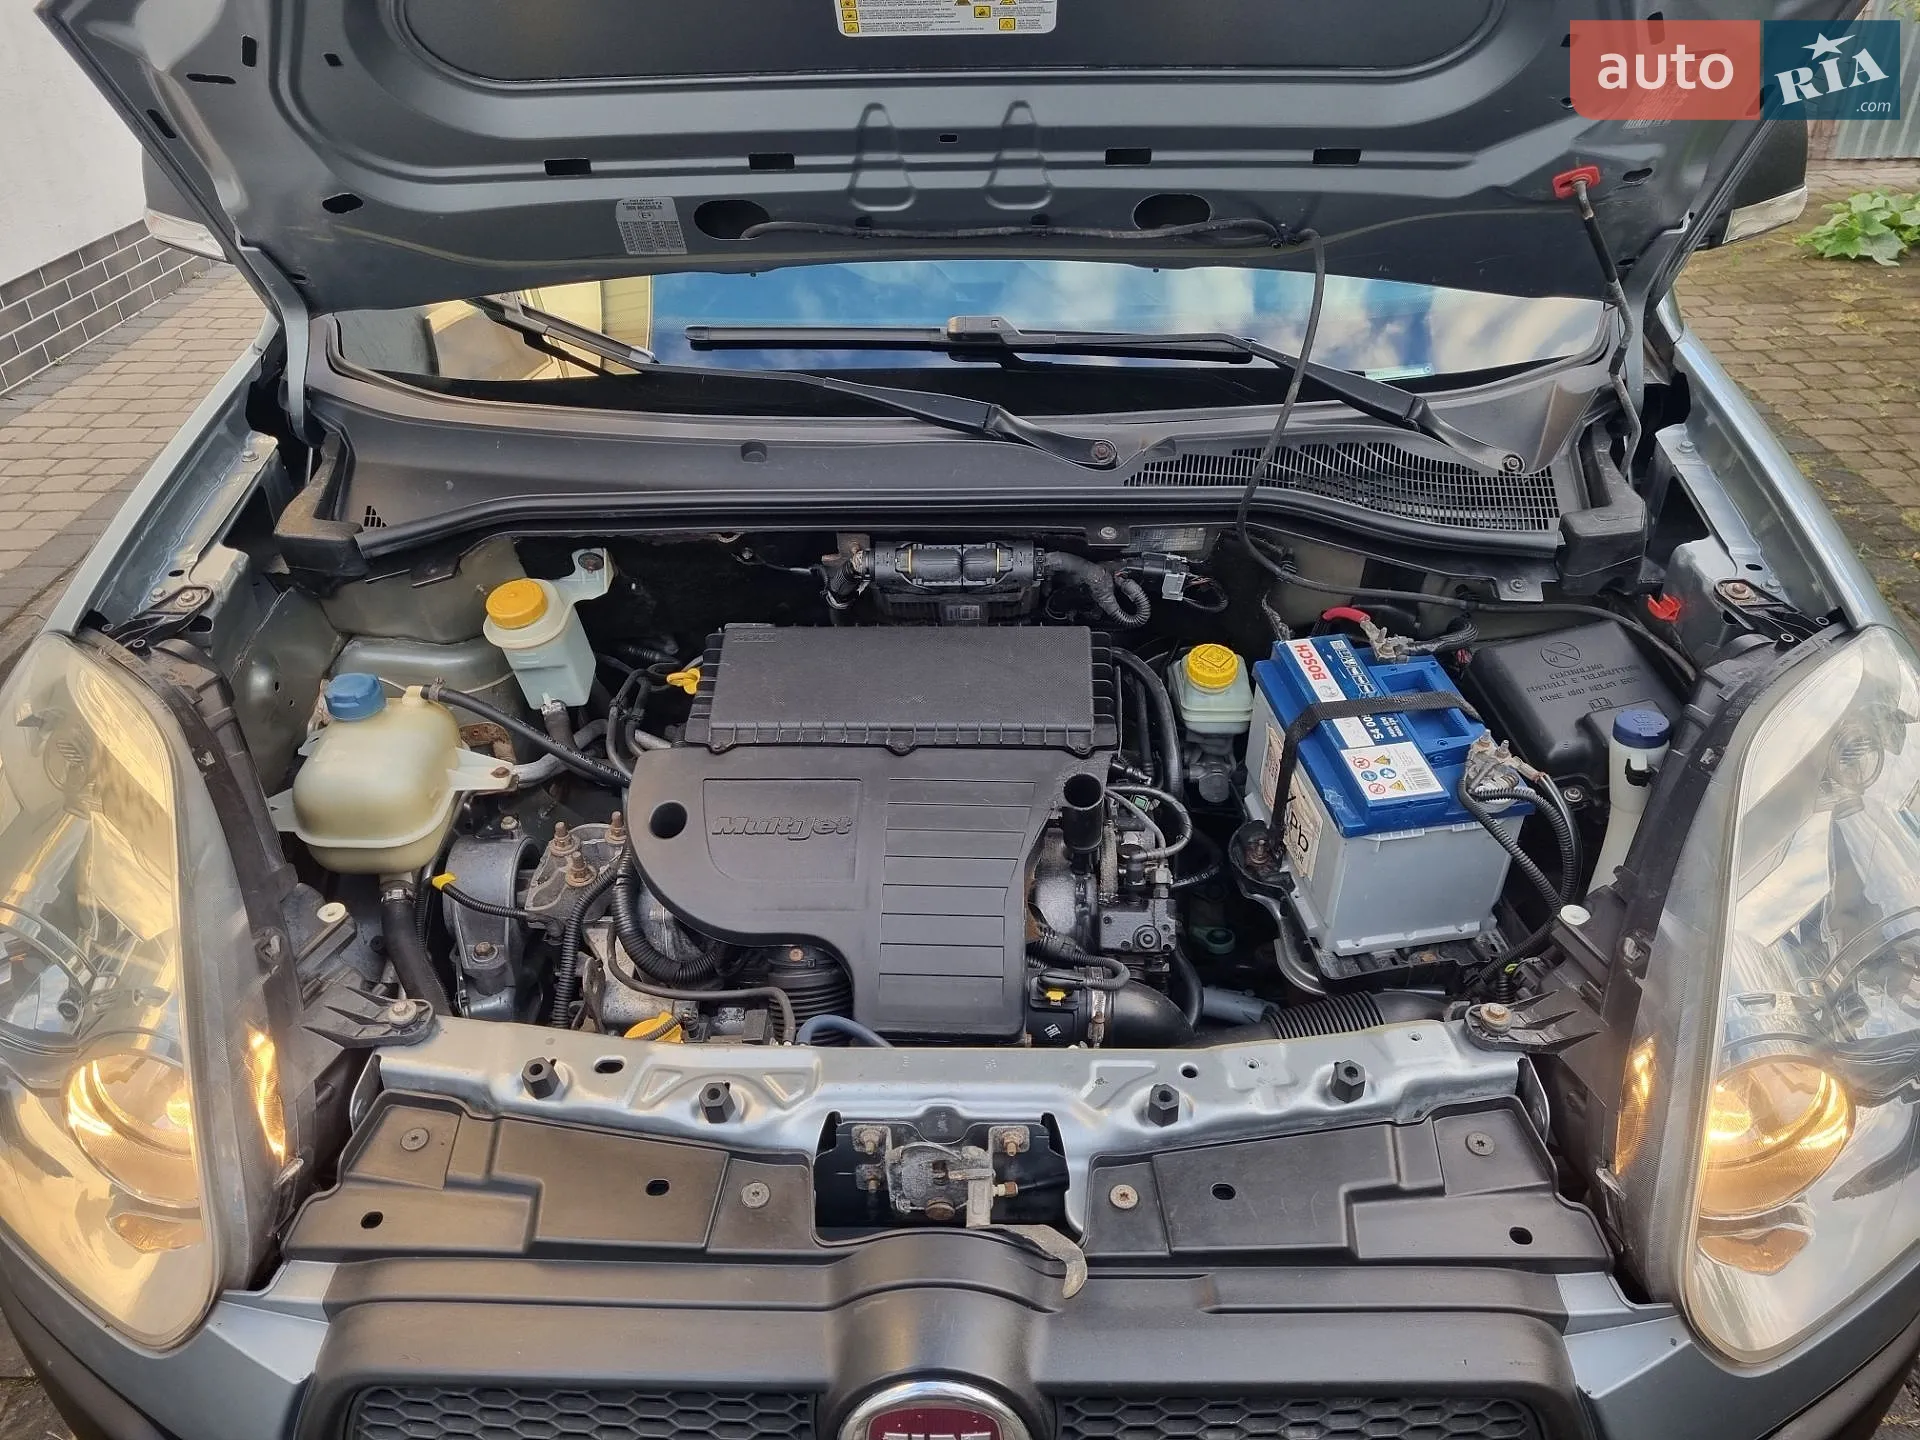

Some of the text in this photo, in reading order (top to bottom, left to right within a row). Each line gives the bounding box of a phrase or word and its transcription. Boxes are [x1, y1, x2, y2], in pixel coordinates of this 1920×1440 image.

[1294, 643, 1328, 681] BOSCH
[1369, 728, 1385, 740] S4
[1290, 811, 1309, 853] Pb
